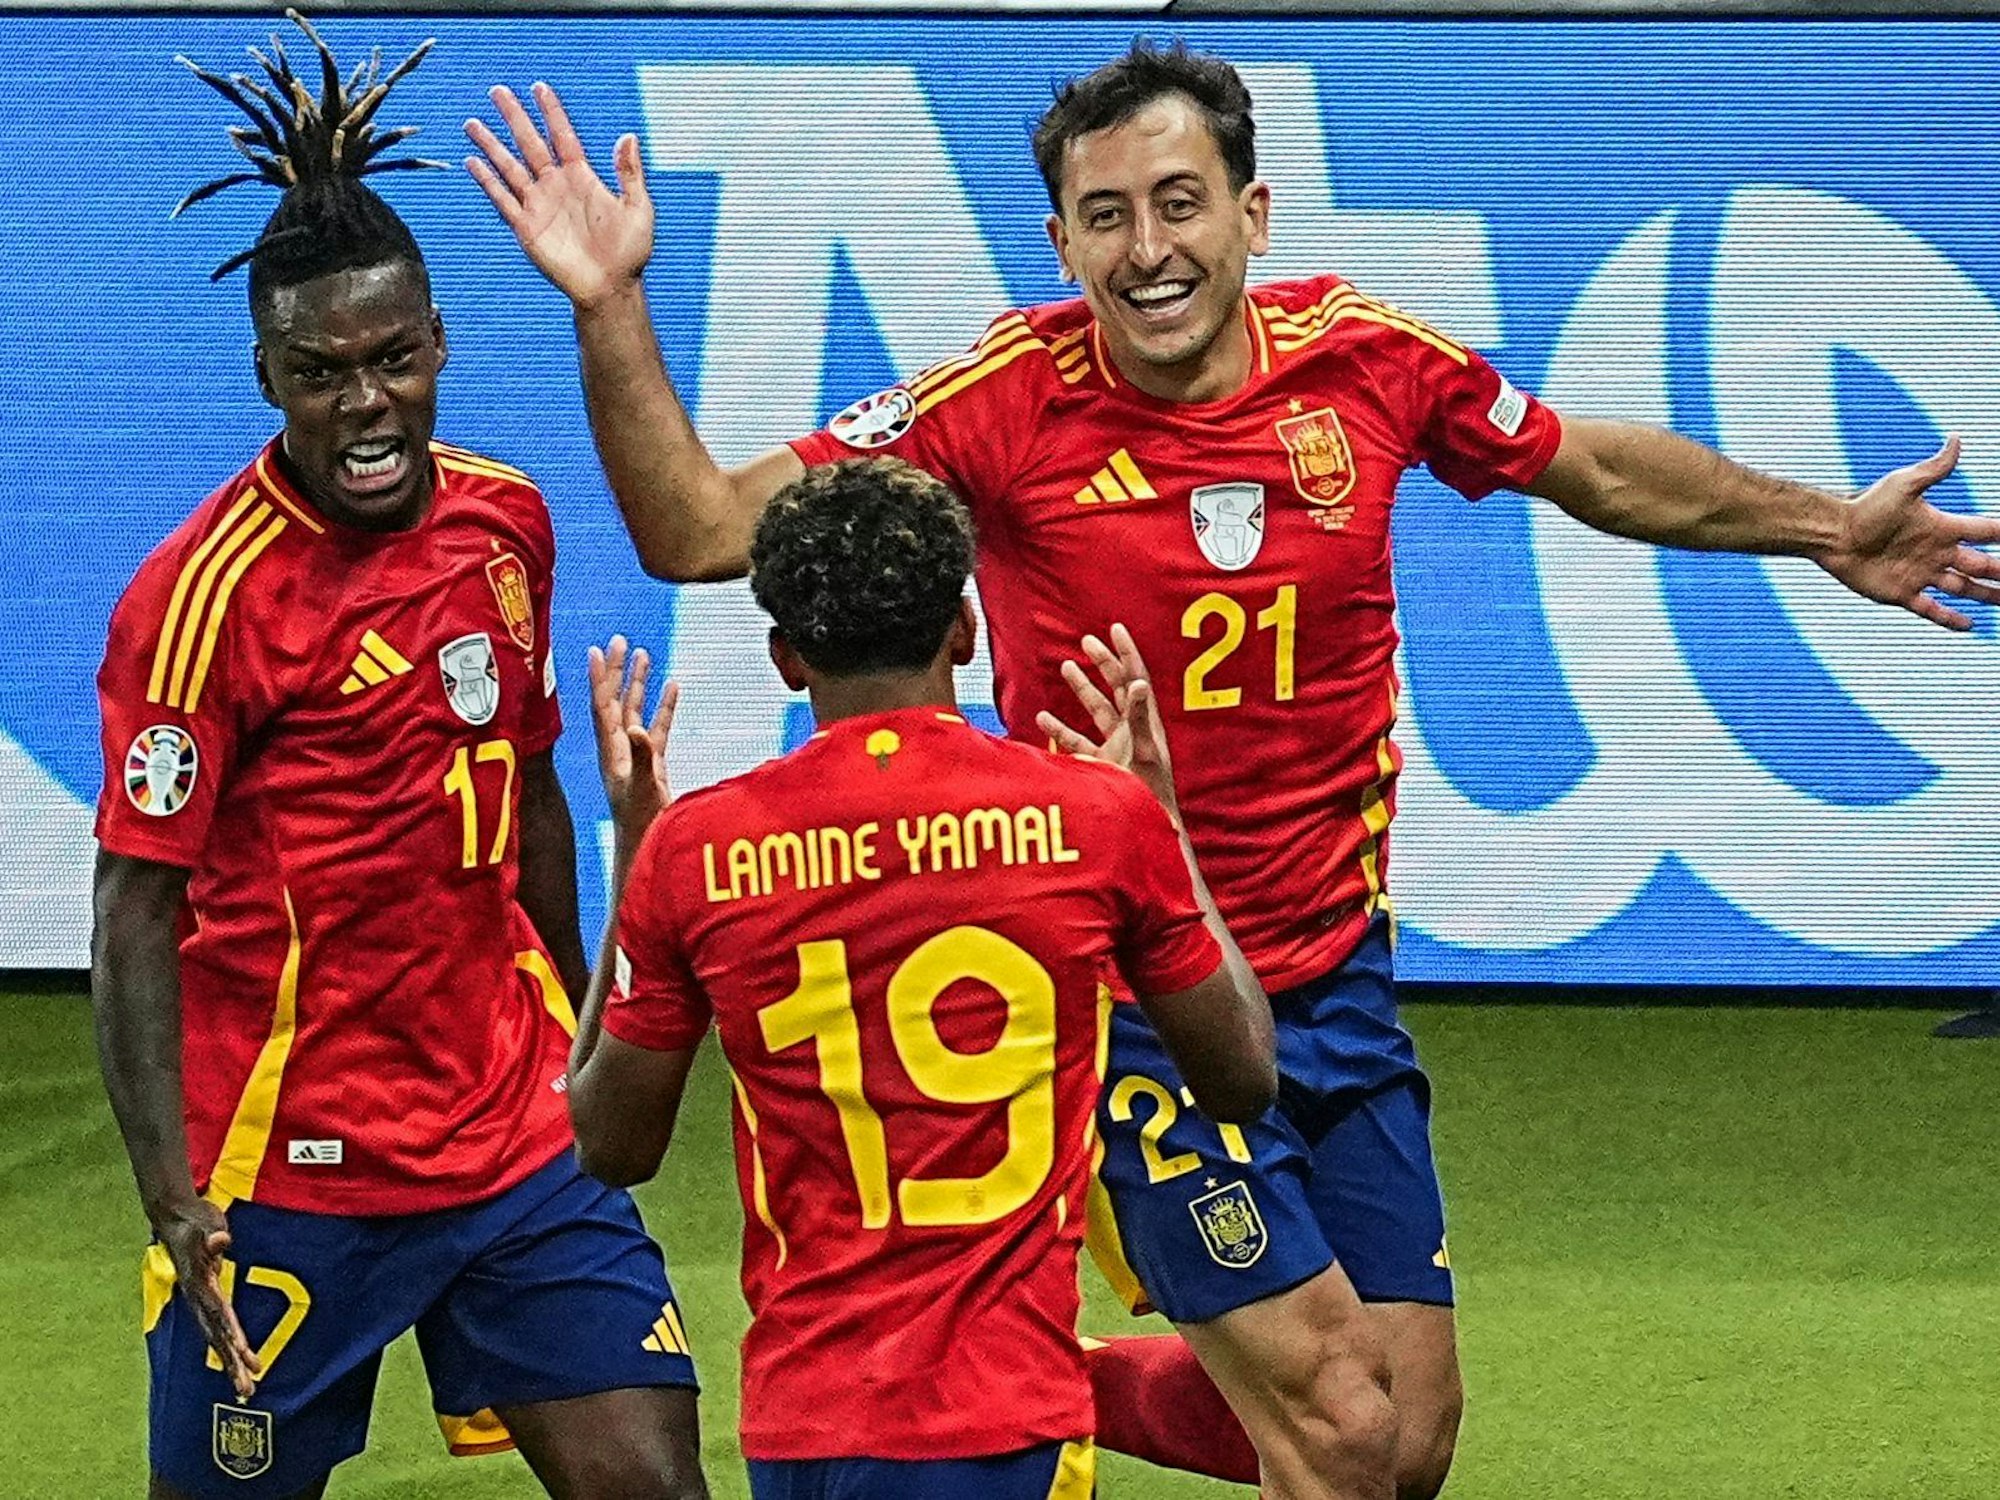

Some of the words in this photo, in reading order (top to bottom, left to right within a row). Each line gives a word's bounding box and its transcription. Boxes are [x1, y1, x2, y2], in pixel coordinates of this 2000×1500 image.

[1181, 584, 1297, 712] 21
[443, 739, 516, 869] 17
[703, 821, 881, 902] LAMINE
[897, 804, 1080, 874] YAMAL
[757, 925, 1056, 1229] 19
